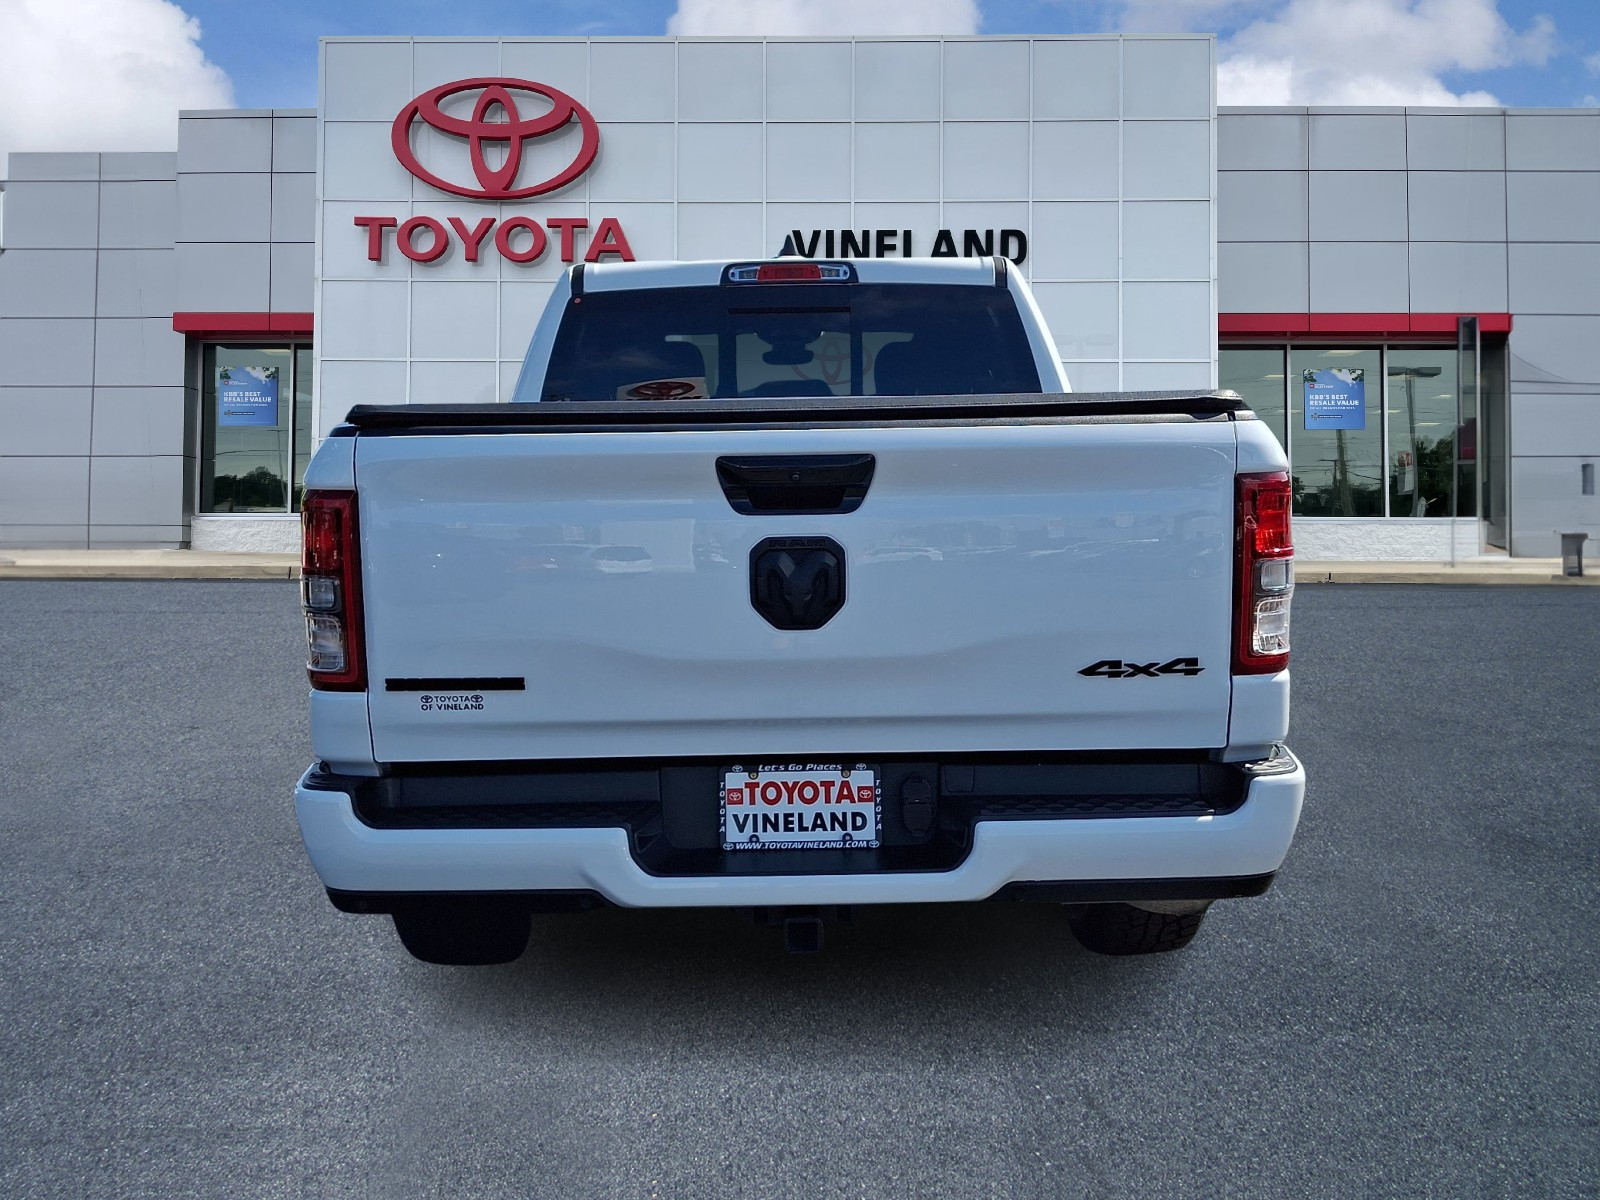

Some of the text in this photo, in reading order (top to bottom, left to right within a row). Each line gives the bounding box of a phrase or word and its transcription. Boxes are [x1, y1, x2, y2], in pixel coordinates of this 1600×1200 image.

[354, 216, 636, 263] TOYOTA
[792, 229, 1028, 266] VINELAND
[768, 538, 826, 548] RAM
[1077, 657, 1206, 678] 4x4
[433, 695, 471, 703] TOYOTA
[421, 703, 484, 711] OF VINELAND
[758, 764, 785, 772] Let's
[805, 763, 843, 771] Places
[744, 780, 857, 806] TOYOTA
[732, 811, 868, 833] VINELAND
[735, 841, 867, 850] WWW.TOYOTAVINELAND.COM
